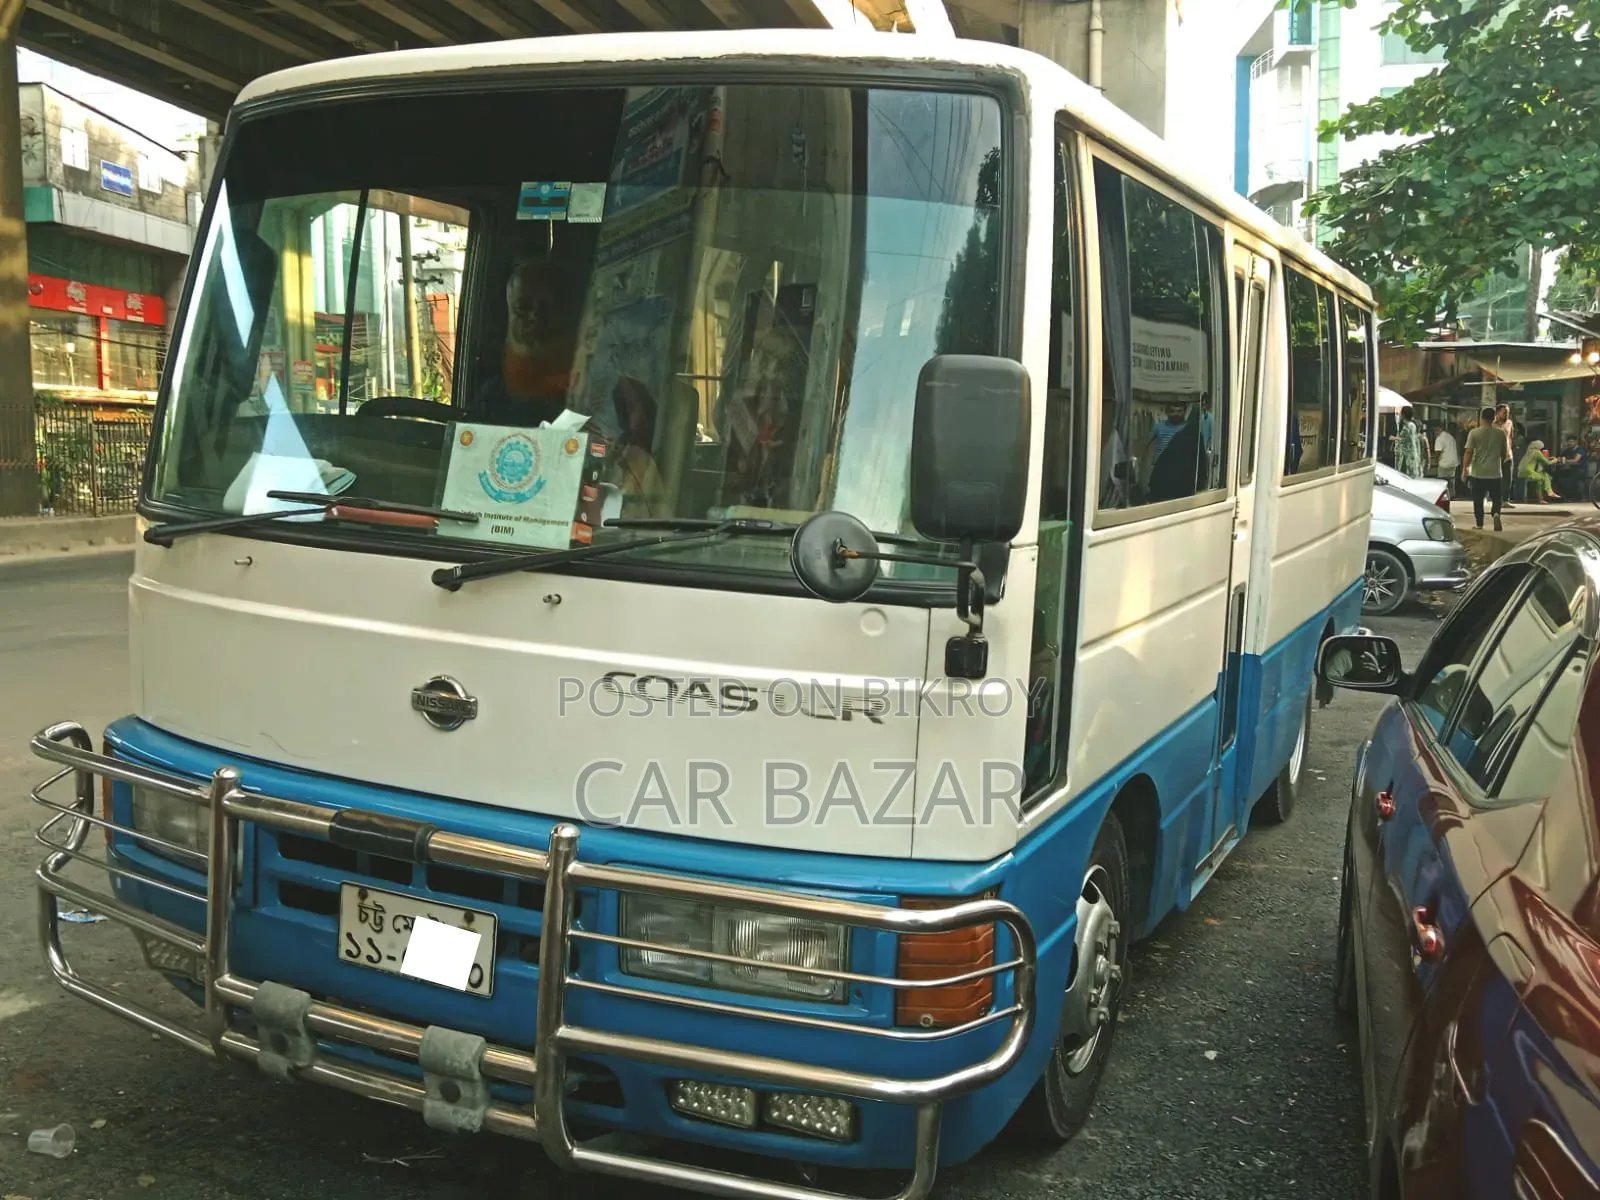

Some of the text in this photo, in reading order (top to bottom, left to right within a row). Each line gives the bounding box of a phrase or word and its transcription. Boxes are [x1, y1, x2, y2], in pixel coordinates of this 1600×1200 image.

[483, 511, 513, 522] Institute
[514, 513, 522, 522] of
[523, 515, 569, 527] Management
[490, 524, 515, 536] (BIM)
[416, 694, 471, 714] NISSAN
[602, 671, 885, 725] COASER
